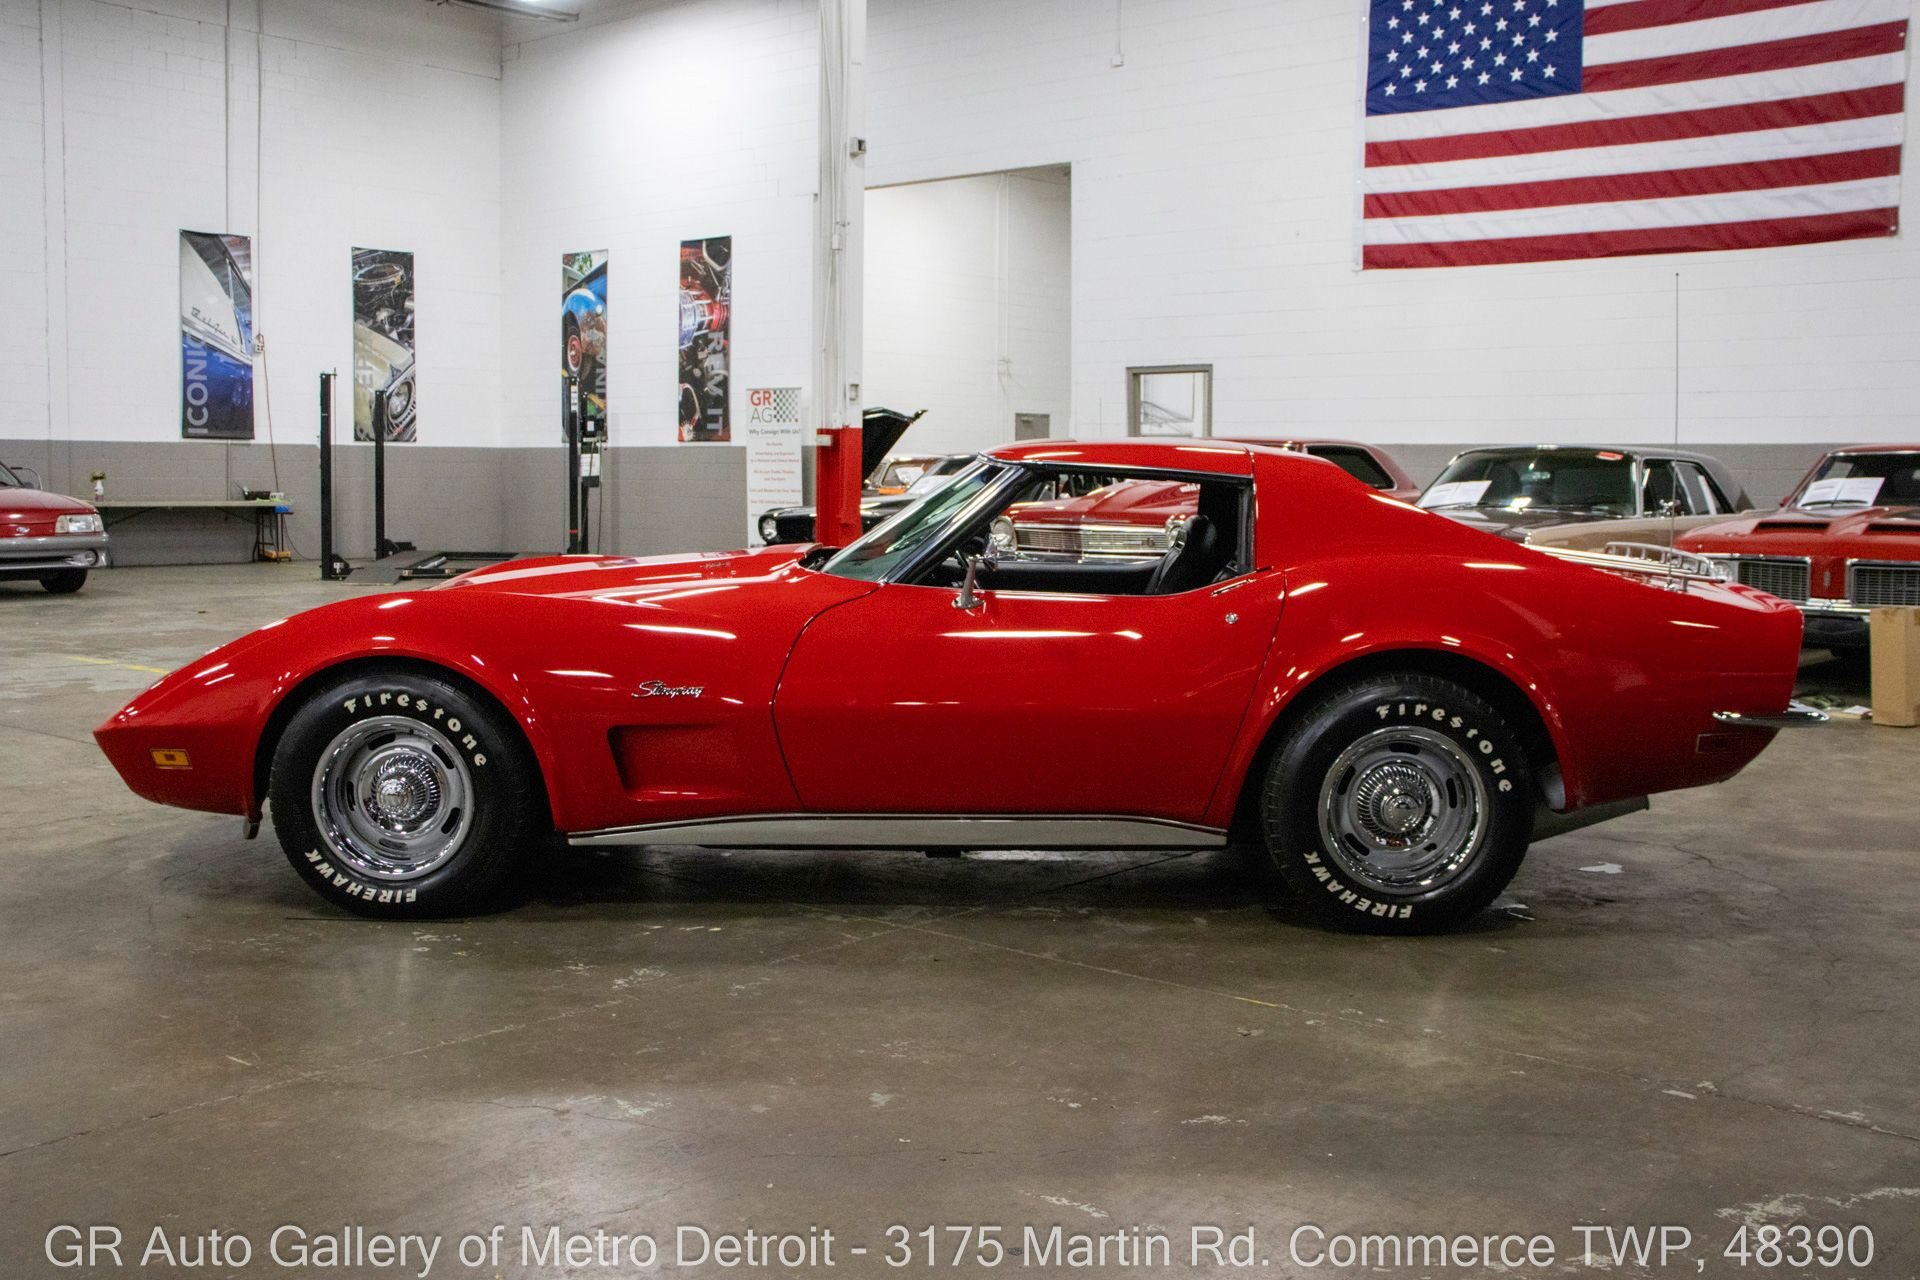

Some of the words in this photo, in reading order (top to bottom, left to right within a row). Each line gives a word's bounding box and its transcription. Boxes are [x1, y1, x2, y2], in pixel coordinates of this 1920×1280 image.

[706, 408, 724, 436] IT
[750, 390, 772, 407] GR
[750, 407, 773, 423] AG
[344, 692, 487, 766] Firestone
[1376, 703, 1512, 792] Firestone
[304, 849, 417, 903] FIREHAWK
[1303, 851, 1413, 919] FIREHAWK
